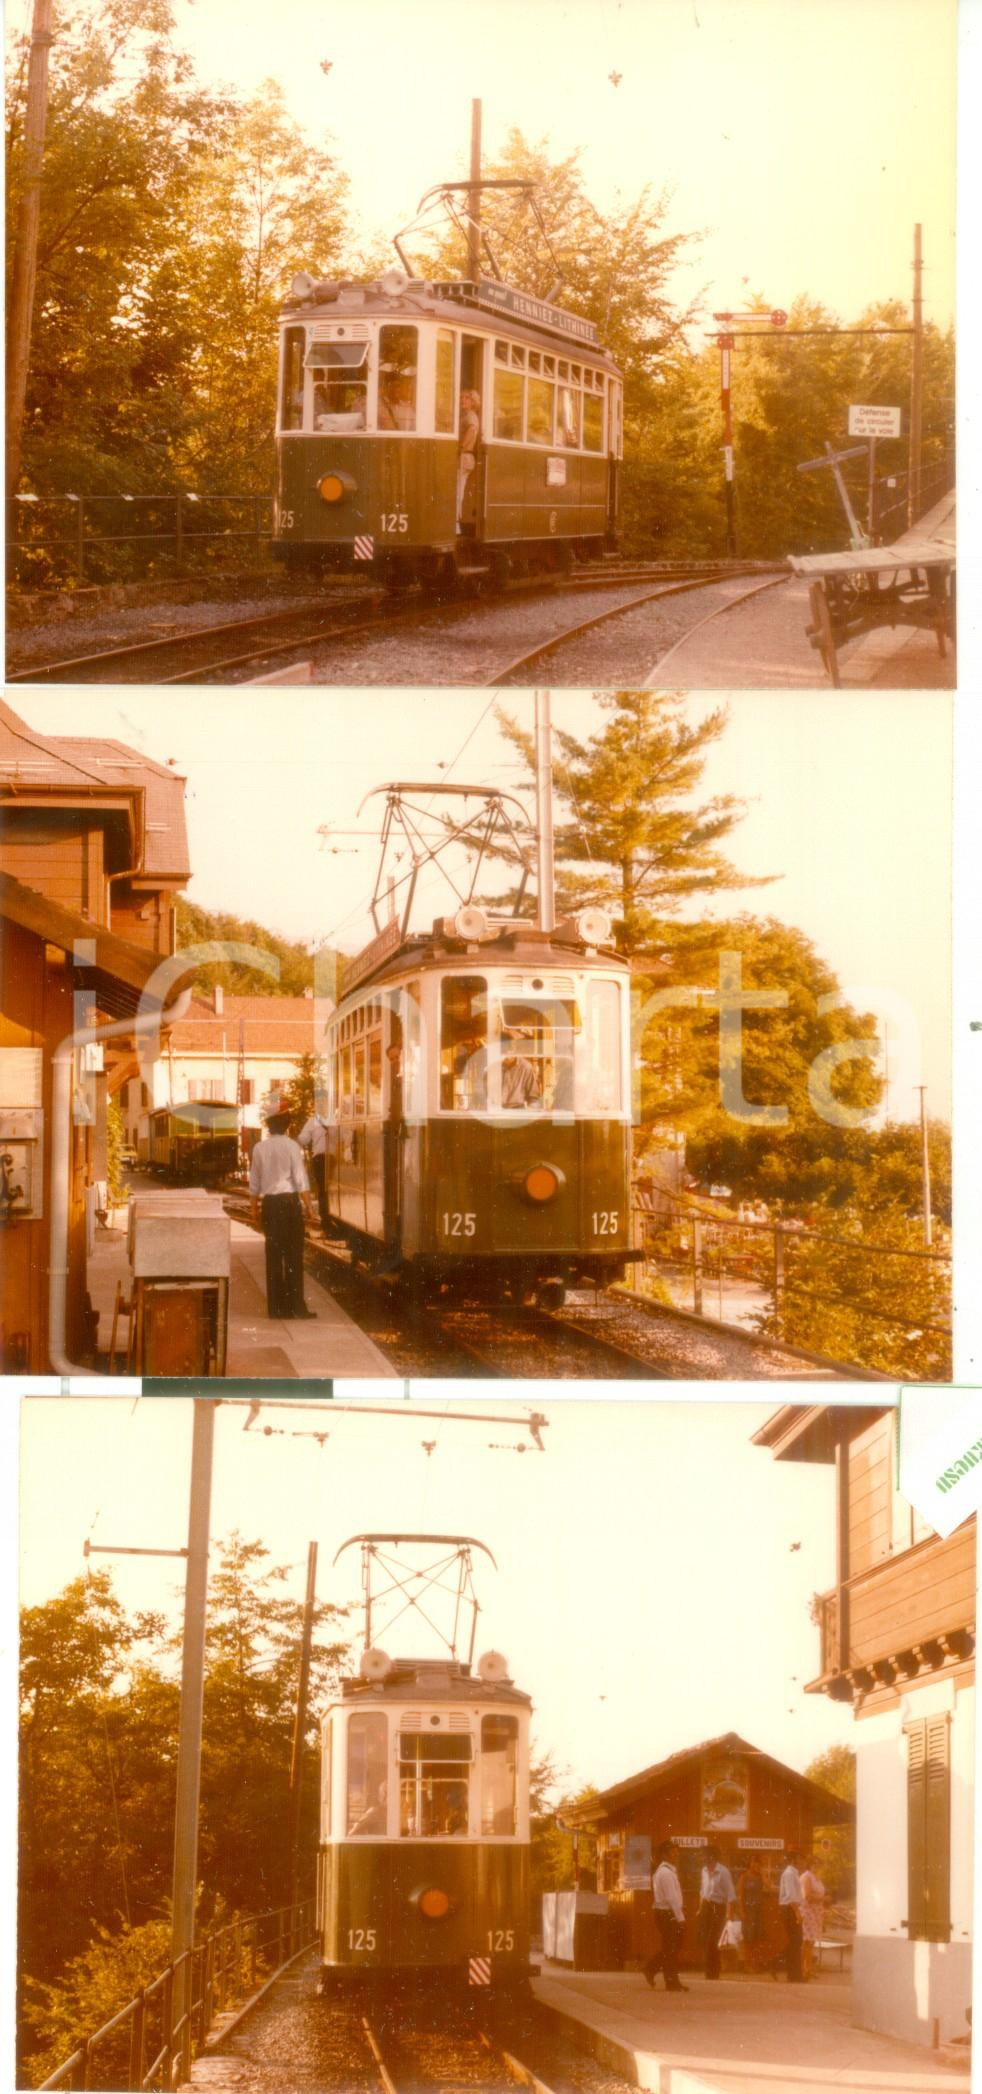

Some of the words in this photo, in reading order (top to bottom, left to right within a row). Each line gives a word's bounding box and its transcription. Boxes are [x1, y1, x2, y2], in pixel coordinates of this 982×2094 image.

[380, 513, 409, 532] 125
[442, 1212, 477, 1236] 125
[592, 1212, 619, 1235] 125
[347, 1929, 377, 1951] 125
[488, 1930, 514, 1951] 125
